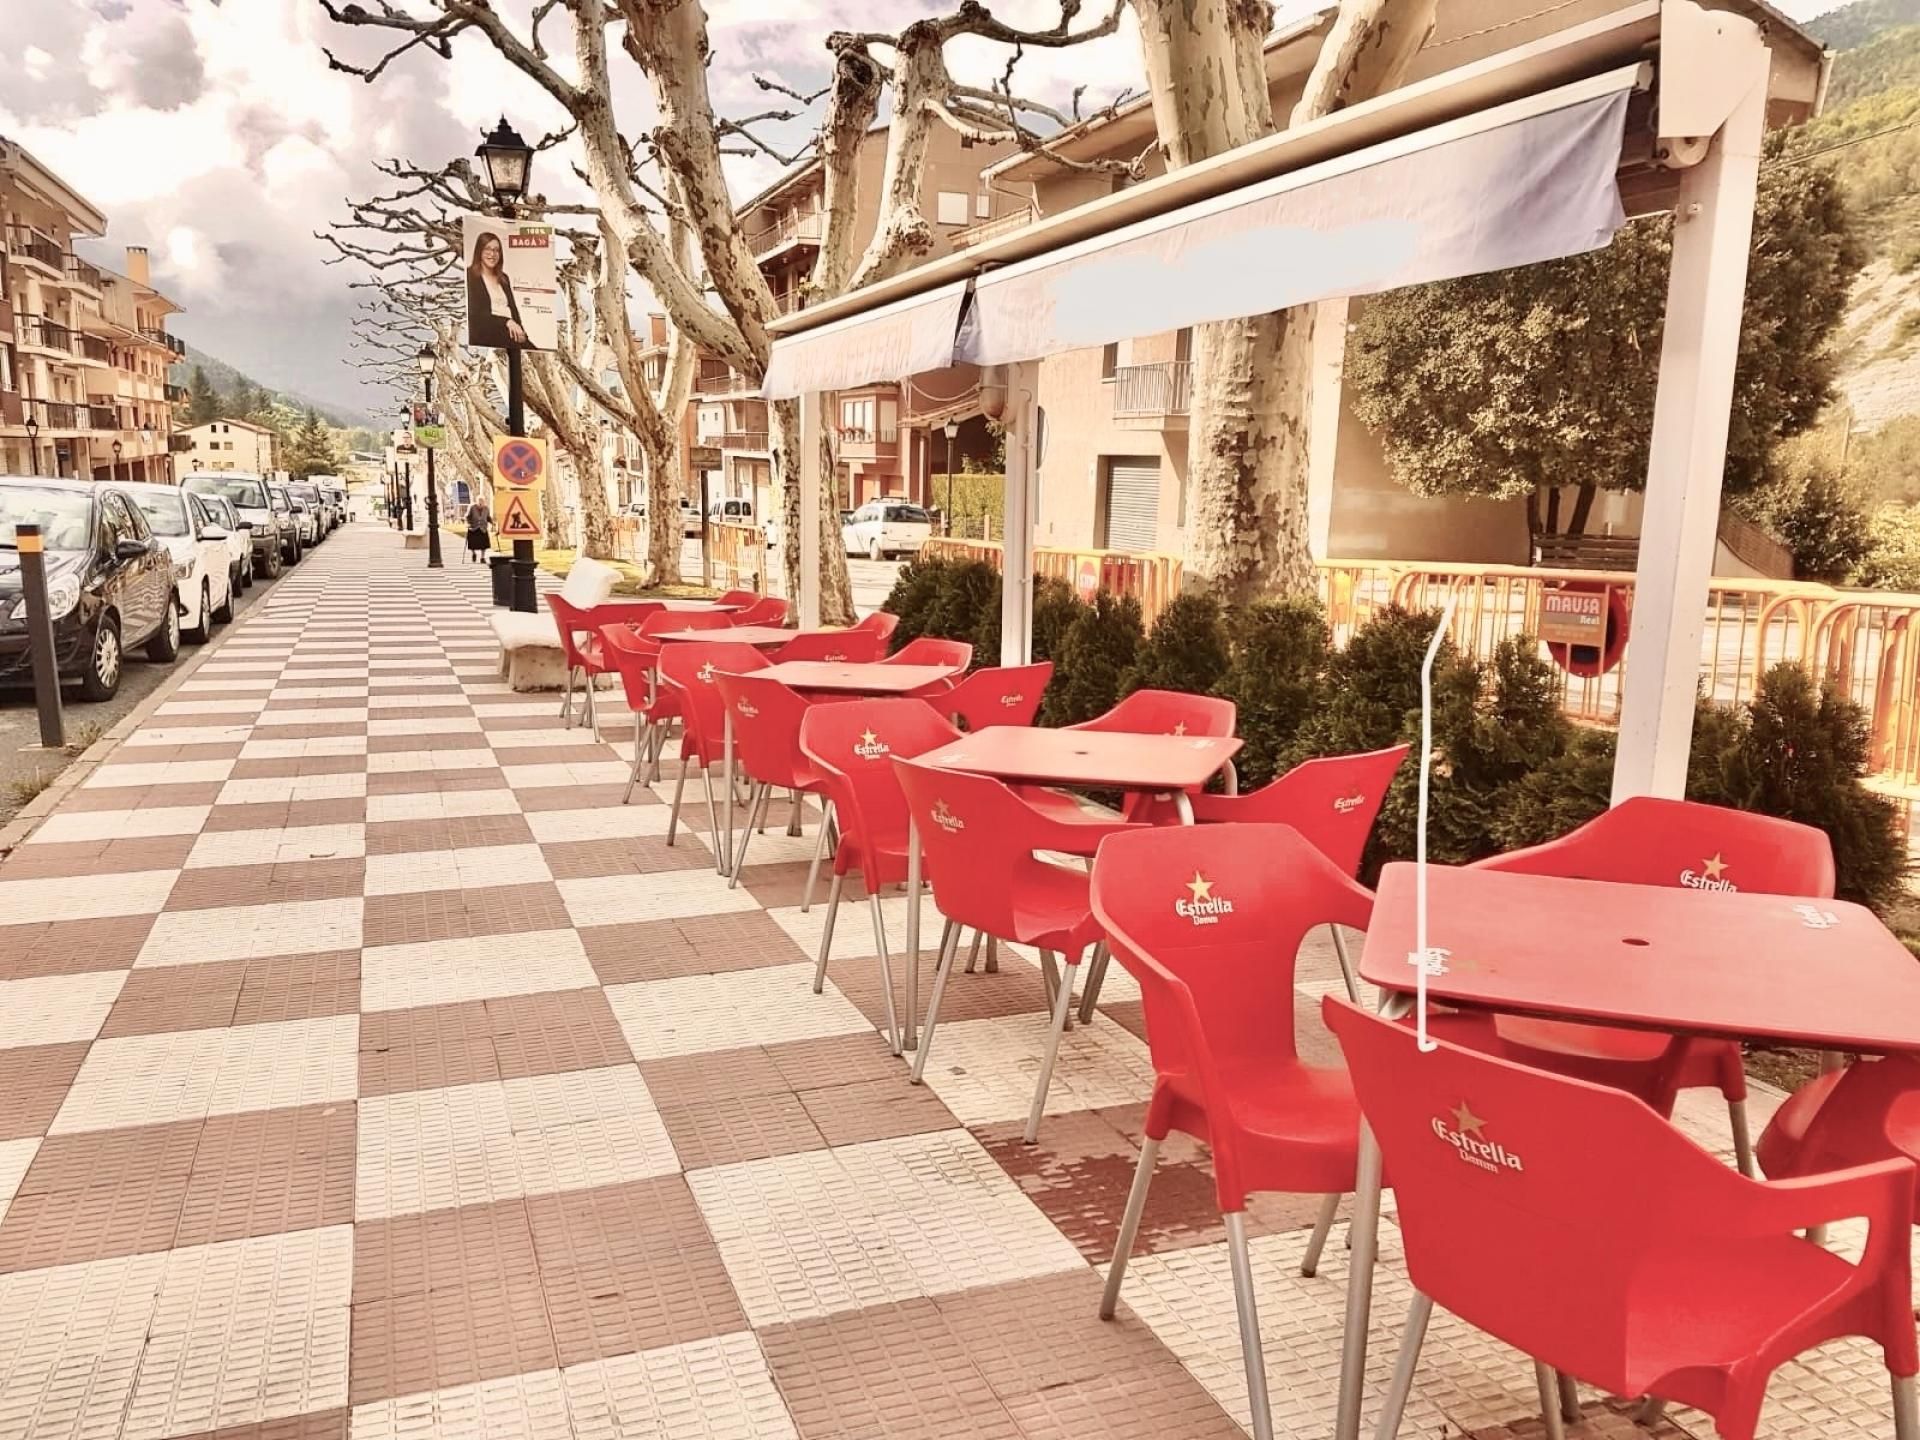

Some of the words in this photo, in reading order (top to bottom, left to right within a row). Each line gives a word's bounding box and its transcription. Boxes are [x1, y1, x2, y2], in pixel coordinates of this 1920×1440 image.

[511, 236, 537, 246] BAGÀ
[1545, 595, 1600, 614] MAUSA
[1680, 869, 1738, 893] Estrella
[1175, 896, 1233, 917] Estrella
[1431, 1116, 1524, 1171] Estrella
